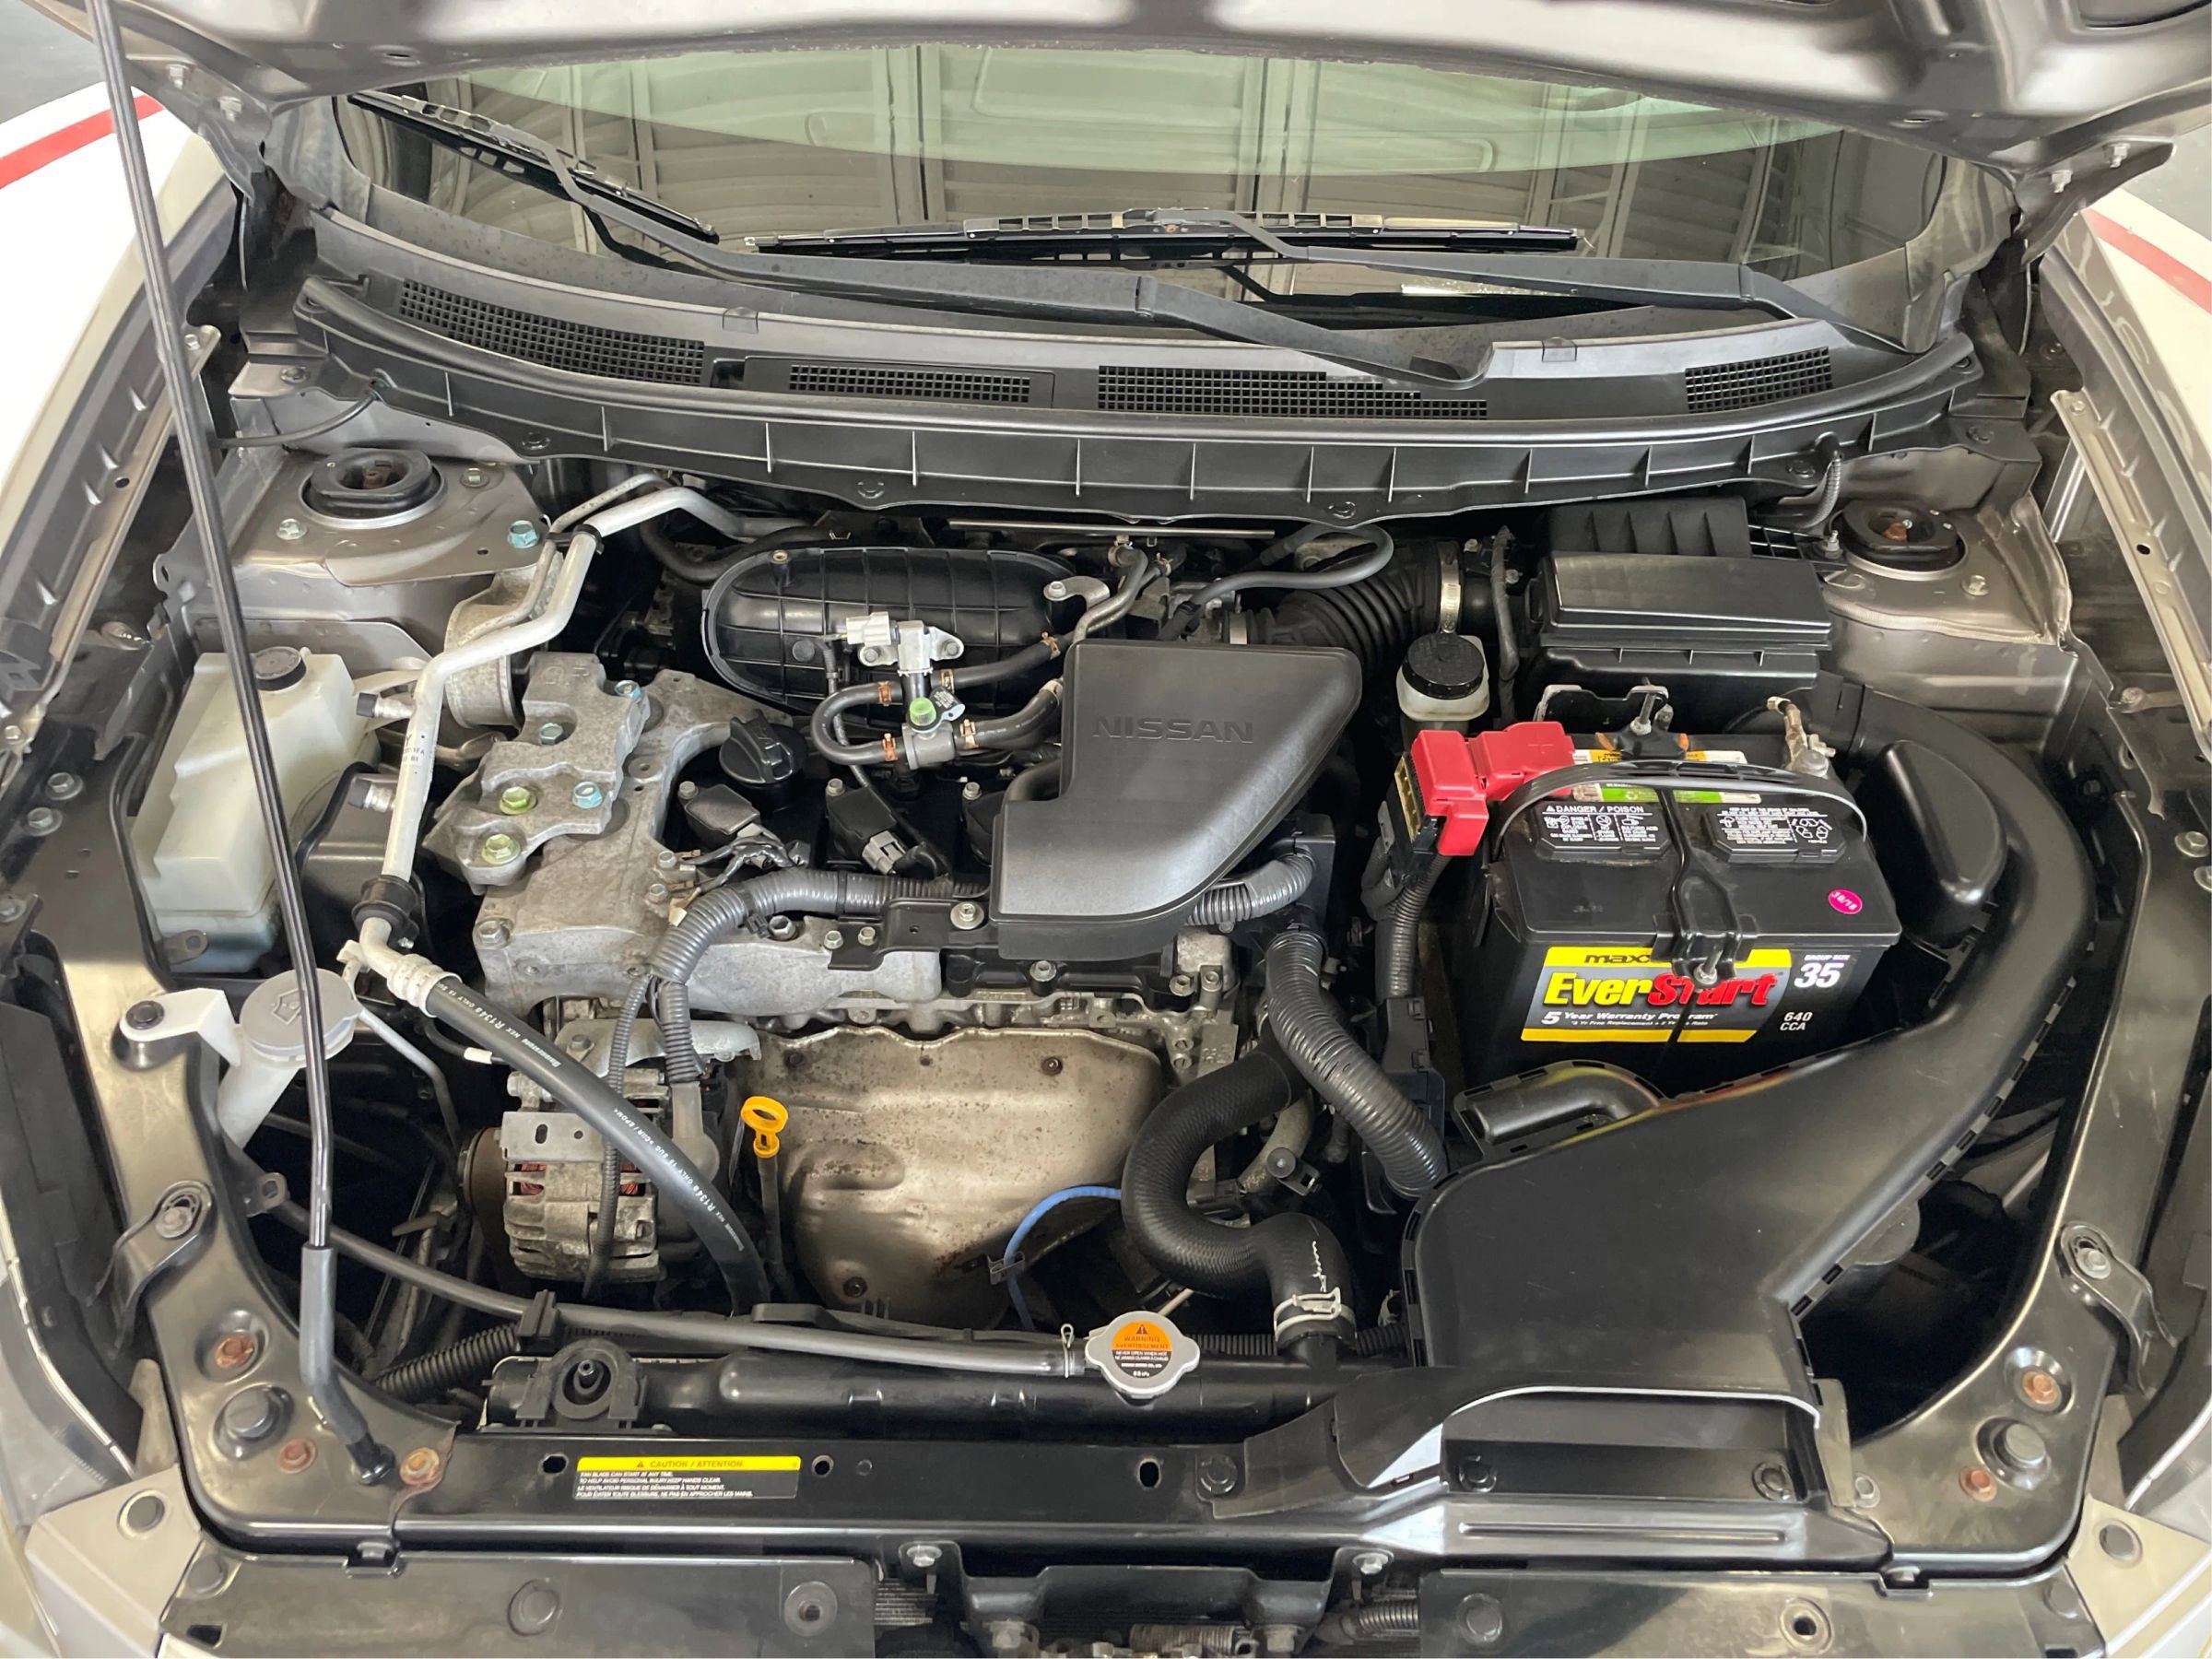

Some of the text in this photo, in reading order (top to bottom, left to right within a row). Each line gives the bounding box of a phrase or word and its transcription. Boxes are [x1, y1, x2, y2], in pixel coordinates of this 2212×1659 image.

[1092, 715, 1254, 744] NISSAN
[1794, 962, 1844, 989] 35
[1543, 972, 1778, 1006] EverStart
[456, 995, 476, 1008] ONLY
[475, 1007, 506, 1030] R134a
[1541, 1011, 1562, 1025] 5
[1596, 1012, 1655, 1020] Warranty
[1783, 1011, 1813, 1022] 640
[505, 1027, 522, 1039] NEX
[1780, 1022, 1806, 1031] CCA
[677, 1168, 694, 1184] ONLY
[692, 1184, 716, 1212] R134a
[650, 1460, 688, 1468] CAUTION
[696, 1460, 744, 1468] ATTENTION
